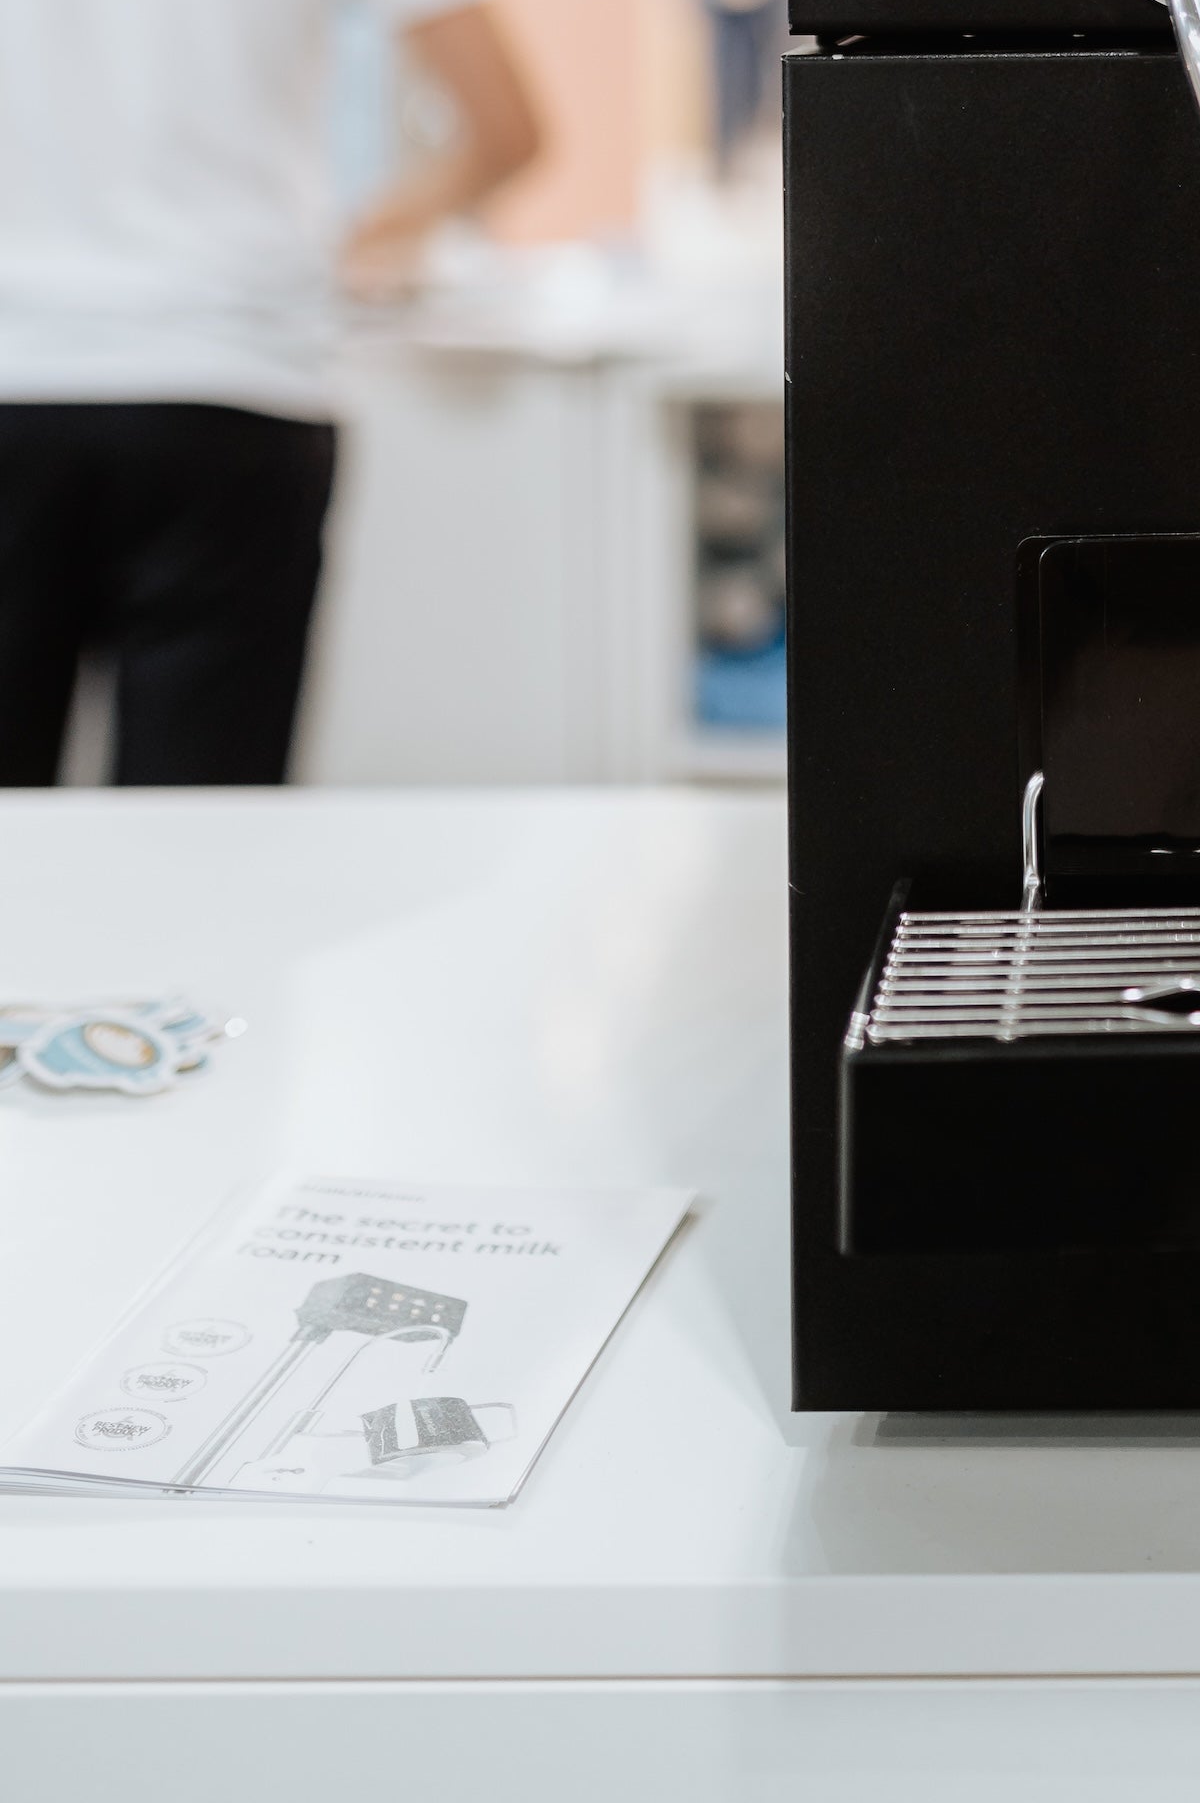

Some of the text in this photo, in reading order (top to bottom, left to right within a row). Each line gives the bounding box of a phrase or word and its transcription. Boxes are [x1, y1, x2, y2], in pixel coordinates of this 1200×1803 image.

[276, 1204, 534, 1237] The secret to
[252, 1226, 563, 1257] consistent milk
